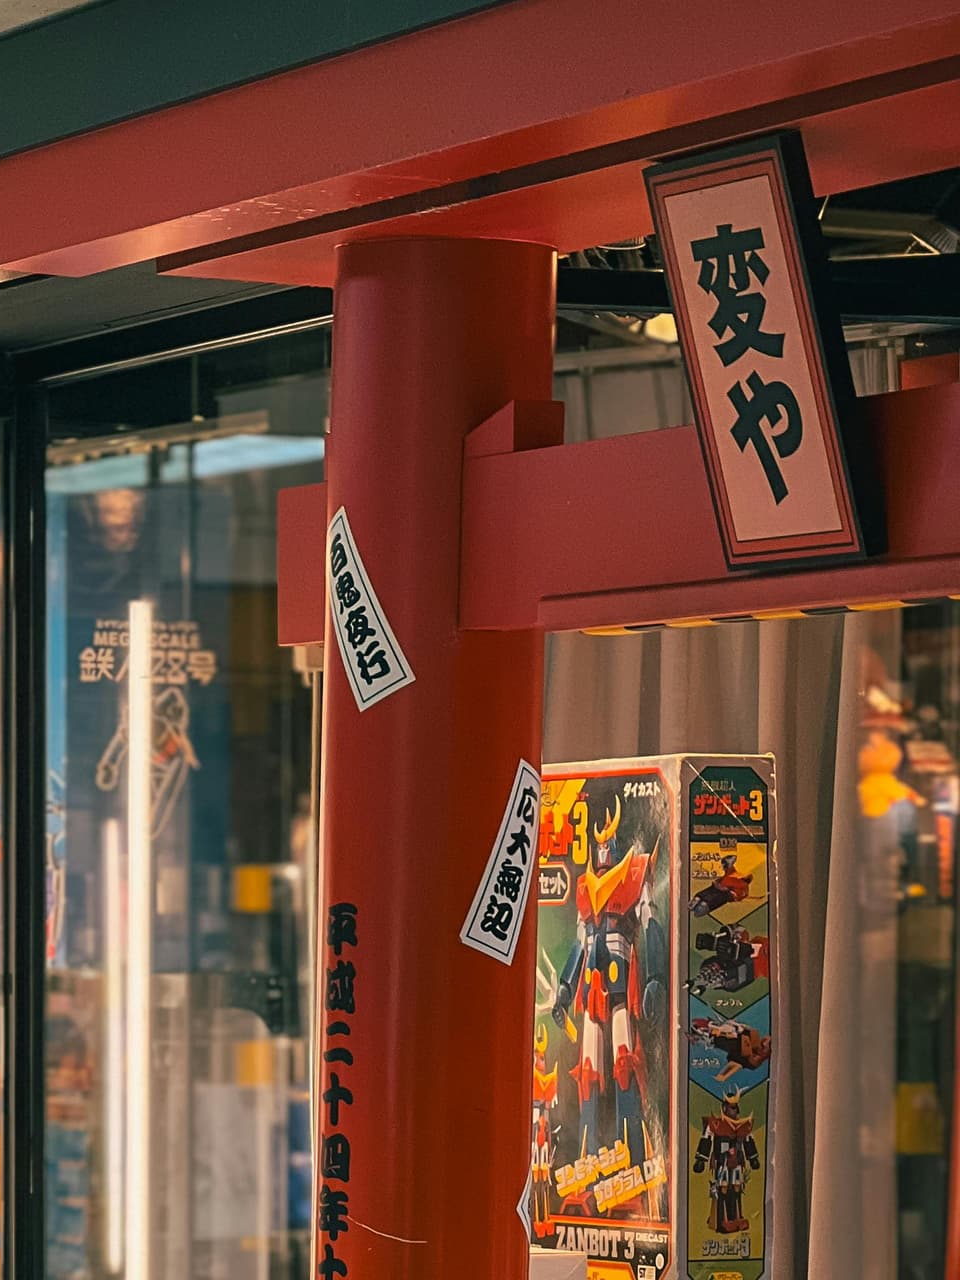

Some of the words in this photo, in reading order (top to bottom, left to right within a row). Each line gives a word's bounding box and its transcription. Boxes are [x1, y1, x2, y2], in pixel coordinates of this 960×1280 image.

[690, 224, 803, 506] 変や
[623, 781, 661, 798] ダイカスト
[693, 790, 763, 821] ザンボット3
[555, 1225, 621, 1258] ZANBOT
[624, 1230, 635, 1260] 3
[635, 1232, 668, 1244] DIECAST
